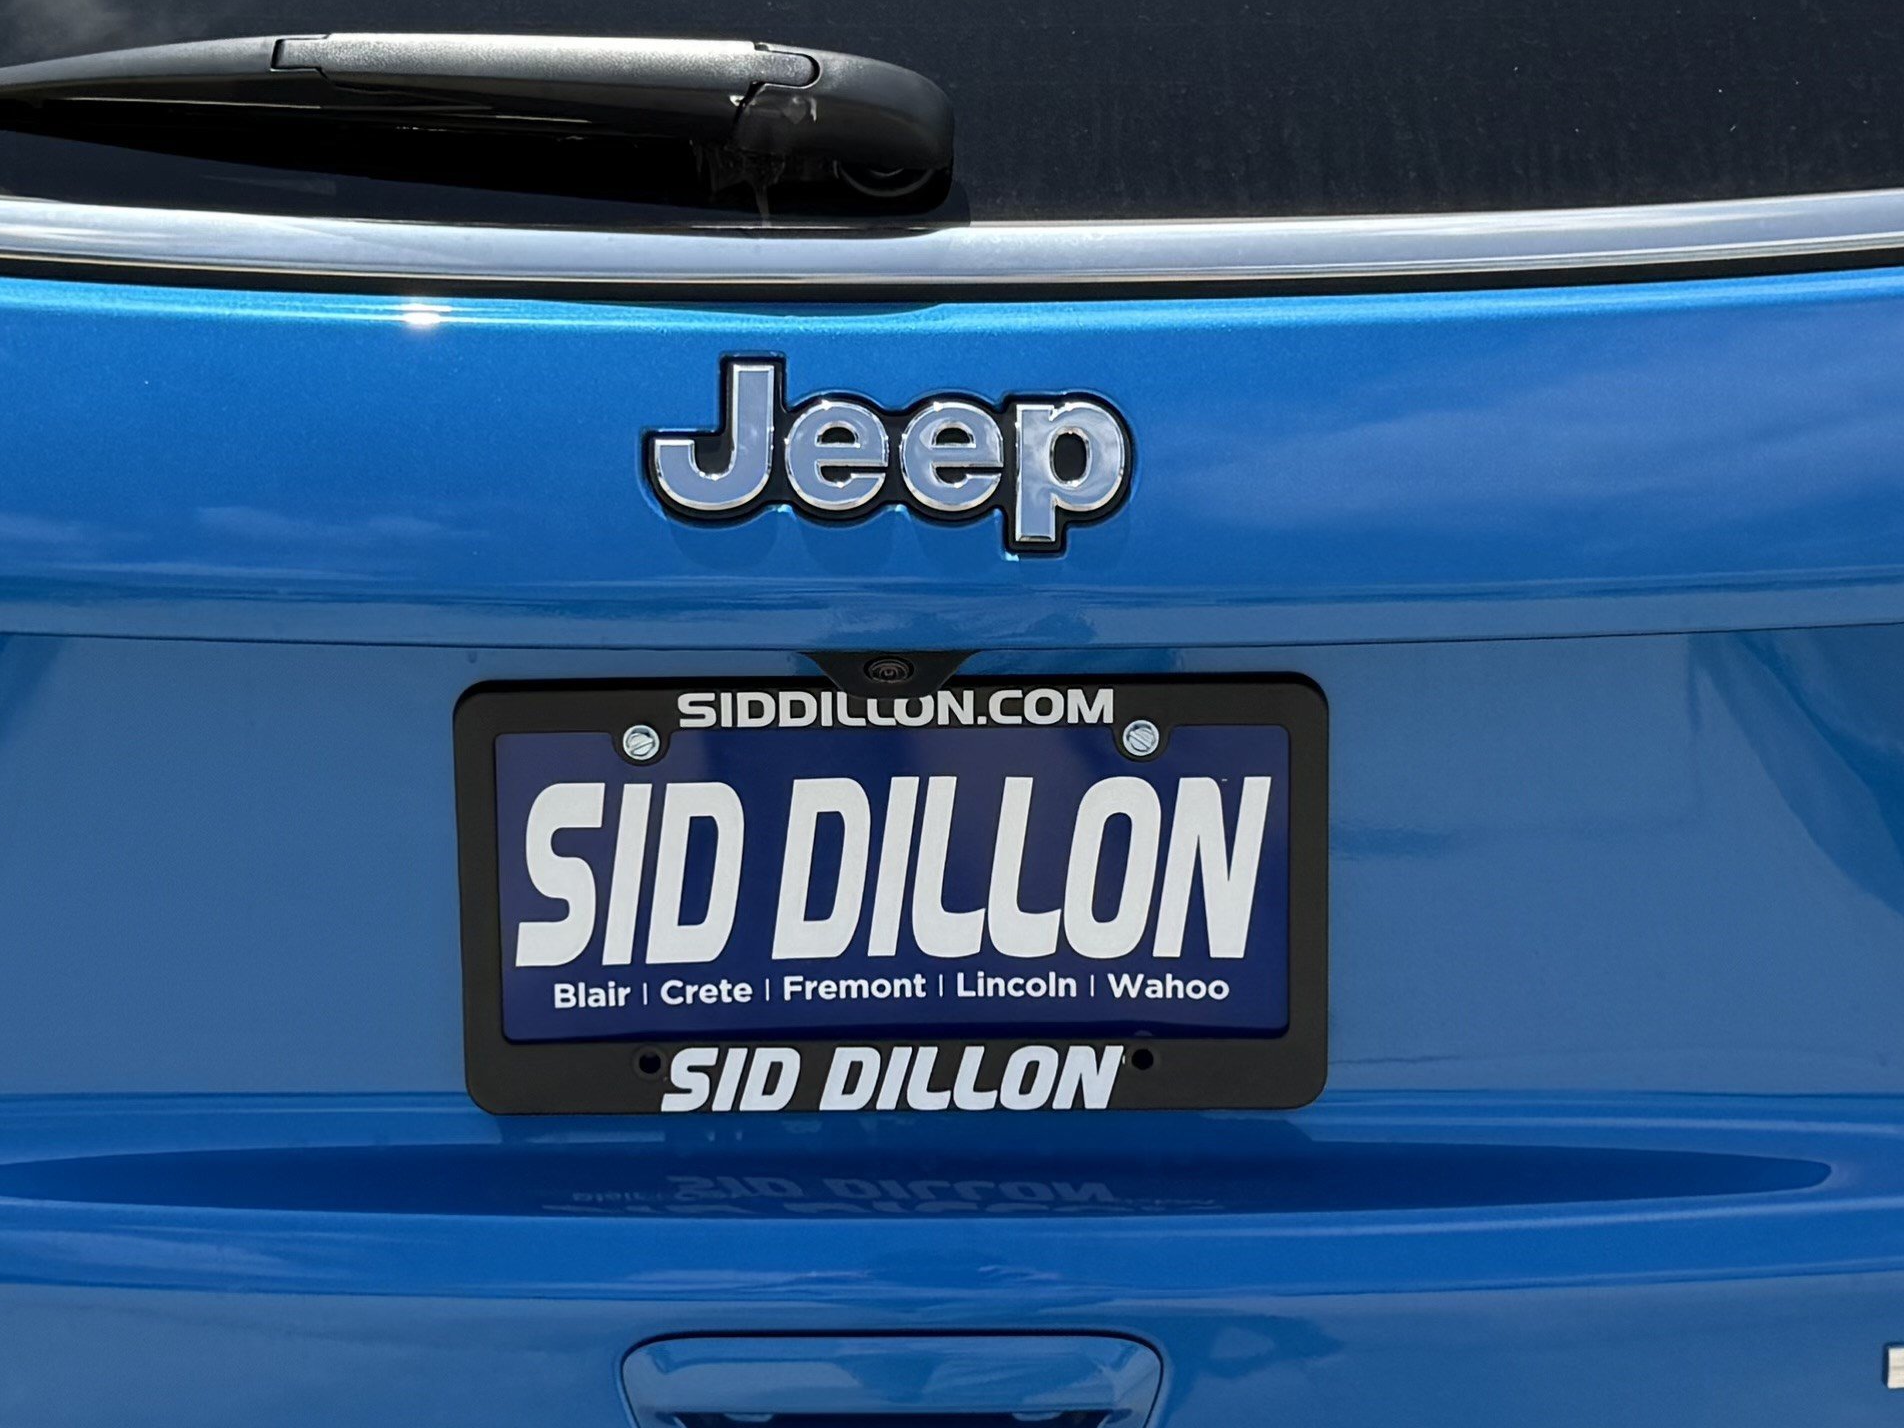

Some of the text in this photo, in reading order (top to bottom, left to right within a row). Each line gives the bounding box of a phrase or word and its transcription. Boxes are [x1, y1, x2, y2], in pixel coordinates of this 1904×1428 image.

[653, 362, 1127, 543] Jeep
[677, 688, 1114, 728] SIDDILLON.COM
[515, 775, 1272, 967] SID DILLON
[554, 971, 1230, 1009] Blair Crete Fremont Lincoln Wahoo
[660, 1045, 1123, 1112] SID DILLON
